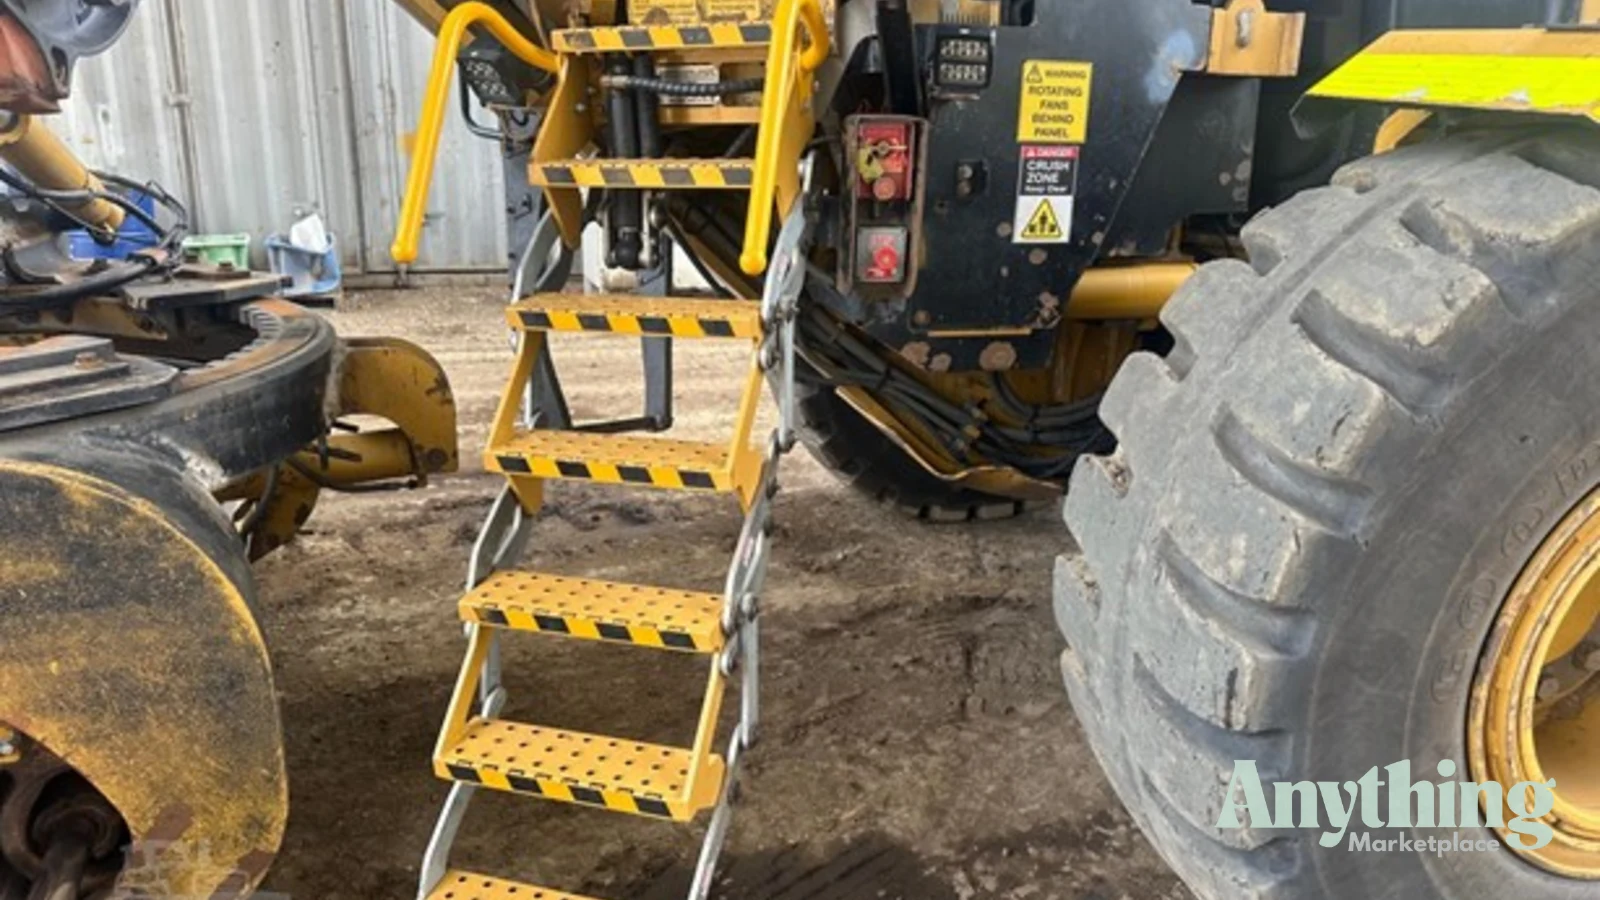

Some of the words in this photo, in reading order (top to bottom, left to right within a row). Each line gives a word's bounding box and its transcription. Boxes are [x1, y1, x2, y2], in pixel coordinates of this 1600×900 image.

[1046, 70, 1086, 79] WARNING
[1028, 86, 1082, 97] ROTATING
[1040, 100, 1068, 110] FANS
[1032, 113, 1074, 124] BEHIND
[1034, 128, 1068, 138] PANEL
[1038, 146, 1073, 157] DANGER
[1026, 160, 1070, 172] CRUSH
[1026, 173, 1059, 183] ZONE
